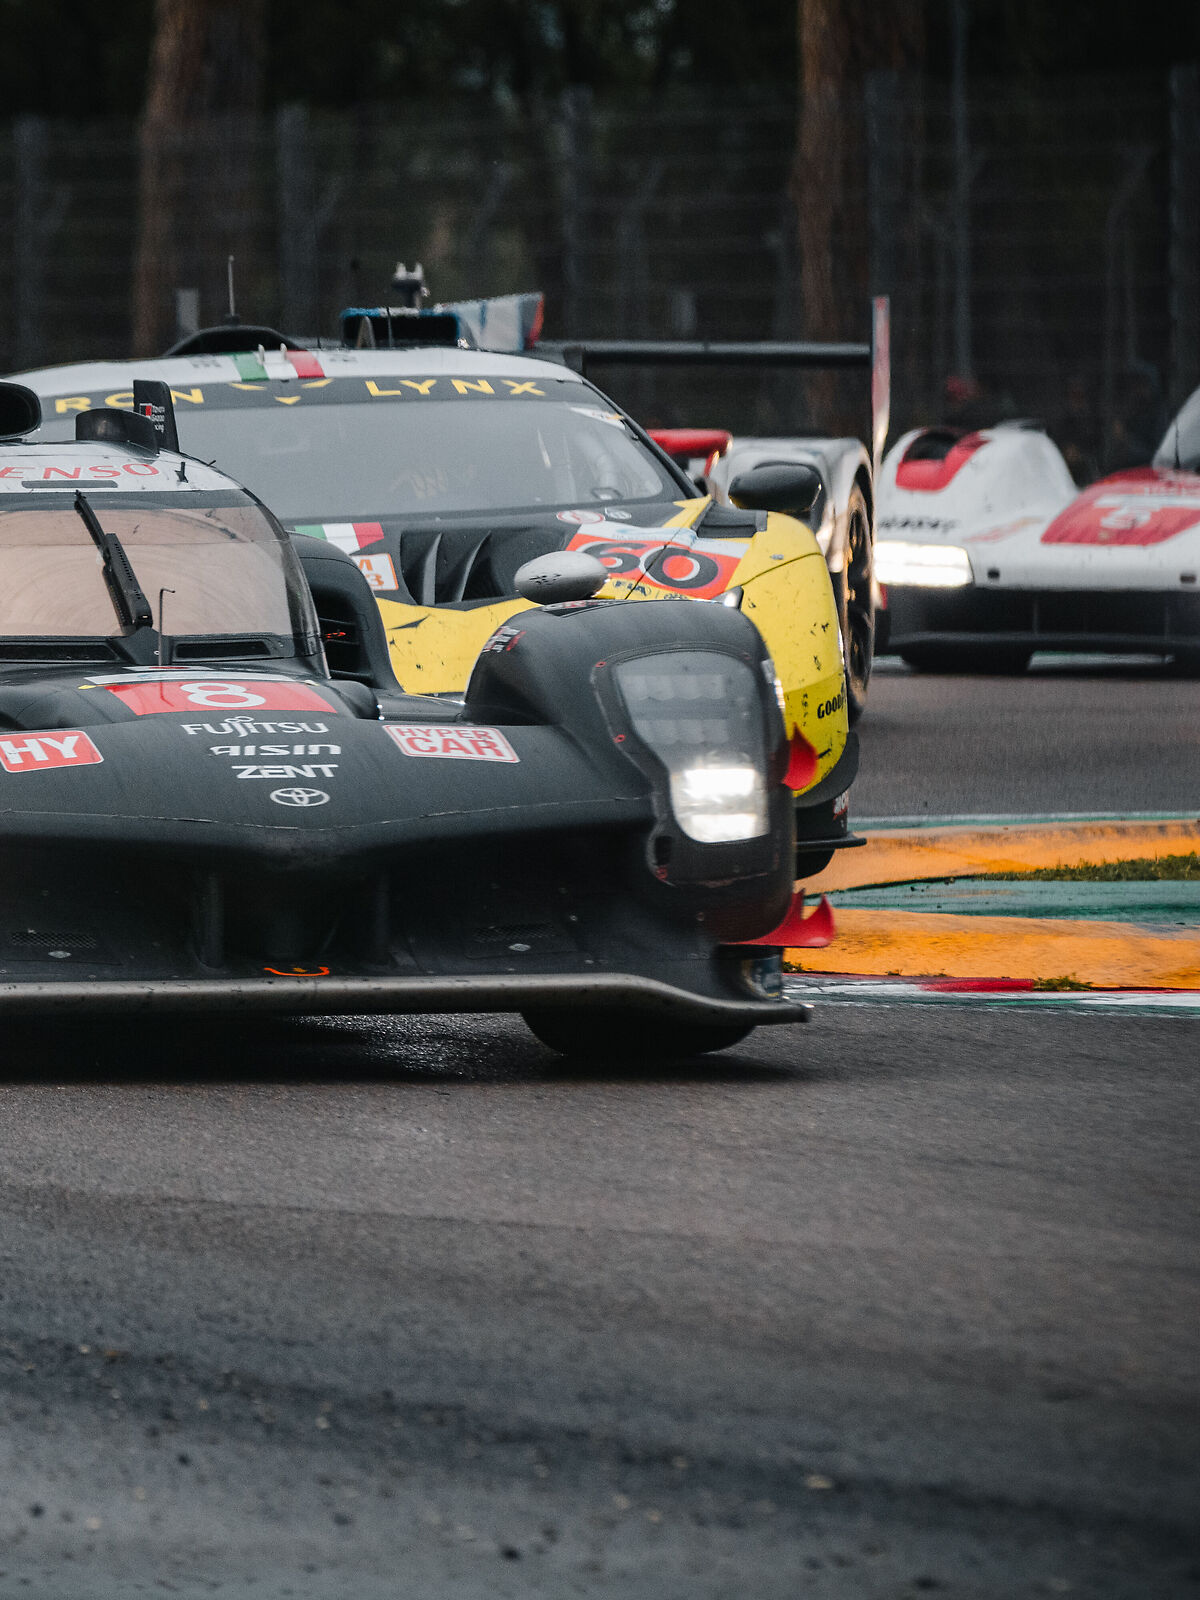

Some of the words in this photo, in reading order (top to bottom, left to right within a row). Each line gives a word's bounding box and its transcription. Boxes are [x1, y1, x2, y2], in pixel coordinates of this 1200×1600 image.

[364, 379, 546, 397] LYNX
[576, 540, 722, 590] 60
[180, 682, 267, 708] 8
[180, 717, 330, 738] FUJITSU
[395, 727, 495, 740] HYPER
[209, 744, 342, 756] AISIN
[405, 736, 505, 757] CAR
[231, 764, 339, 779] ZENT
